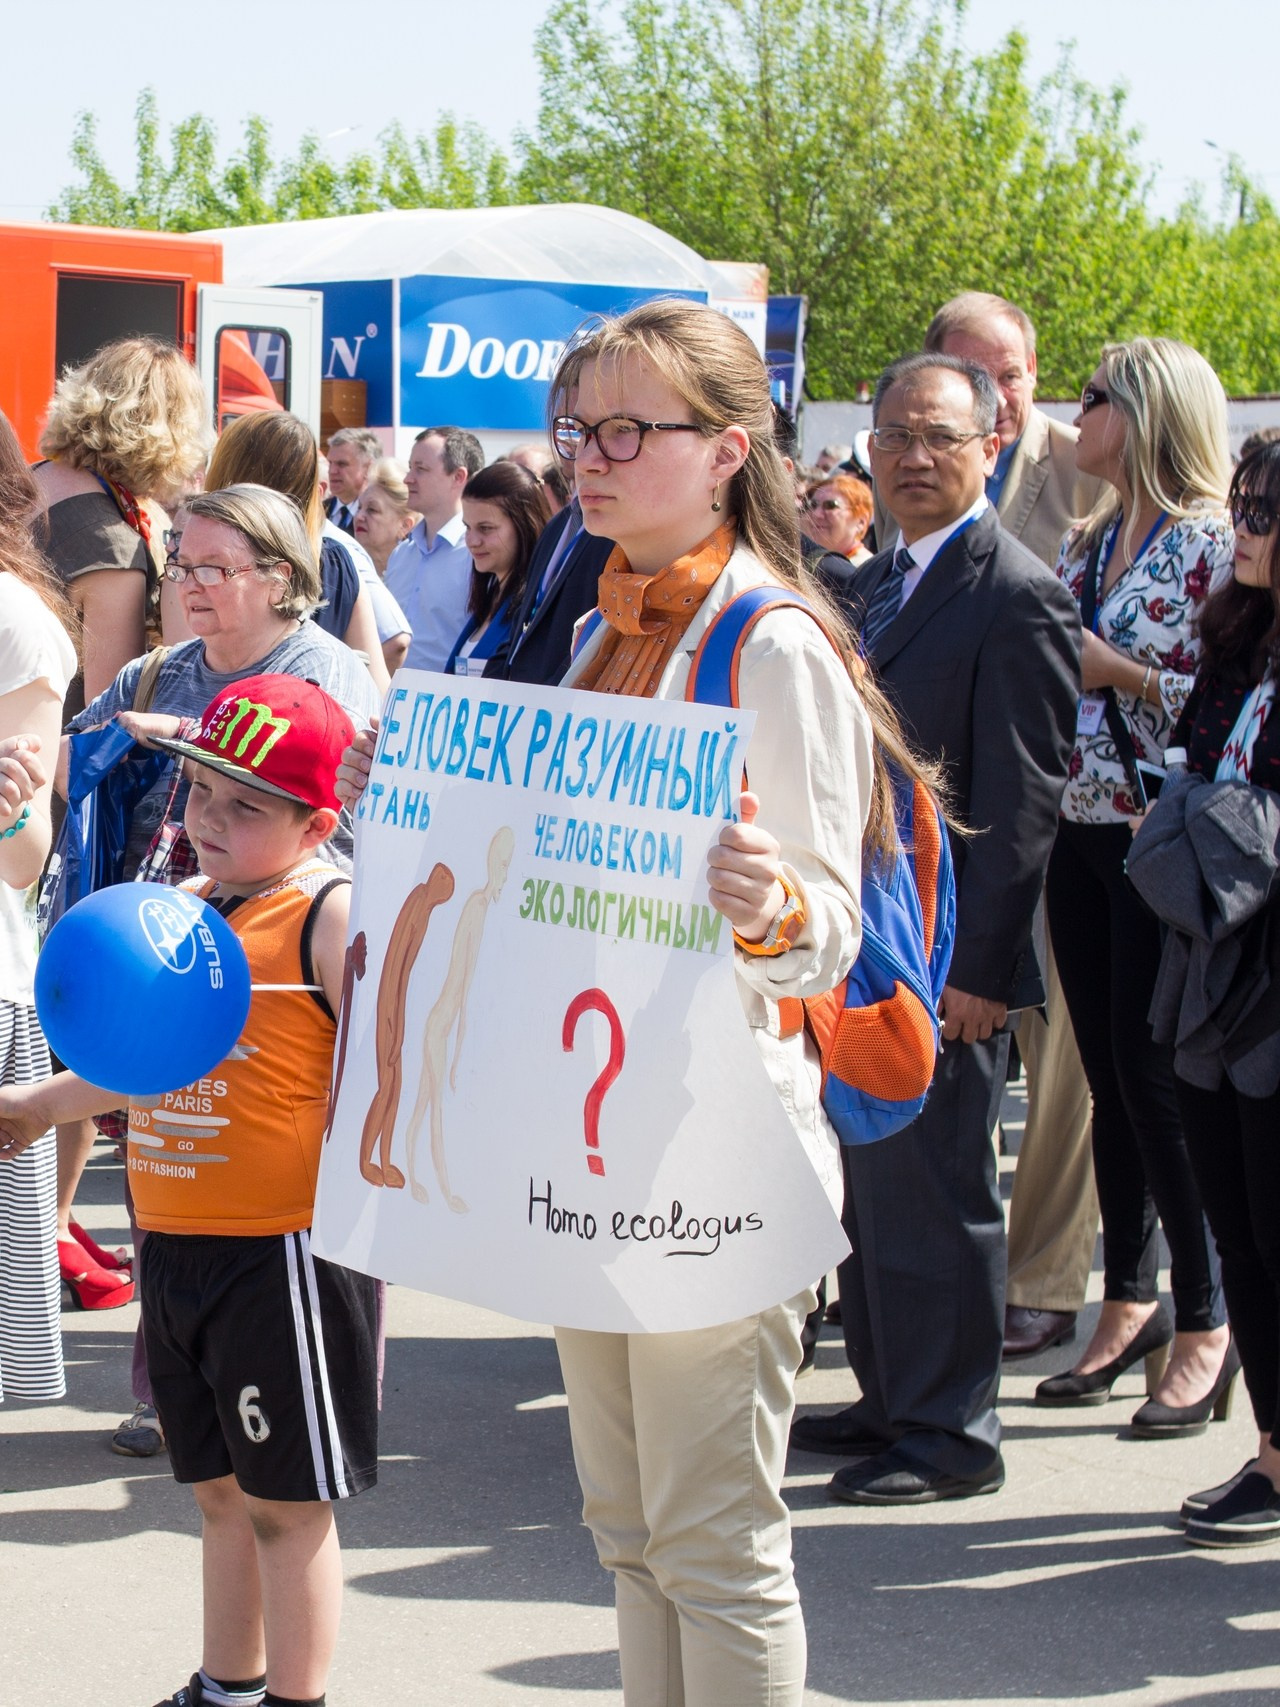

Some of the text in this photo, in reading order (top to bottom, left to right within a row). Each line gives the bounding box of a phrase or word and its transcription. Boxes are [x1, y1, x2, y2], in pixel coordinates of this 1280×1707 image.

[1081, 704, 1097, 716] VIP
[534, 814, 682, 878] ЧЕЛОВЕКОМ
[520, 881, 721, 952] ЭКОЛОГИЧНЫМ
[164, 1092, 213, 1113] PARIS
[177, 1140, 194, 1151] GO
[150, 1161, 196, 1179] FASHION
[528, 1176, 763, 1257] Homo ecologus
[237, 1385, 271, 1444] 6
